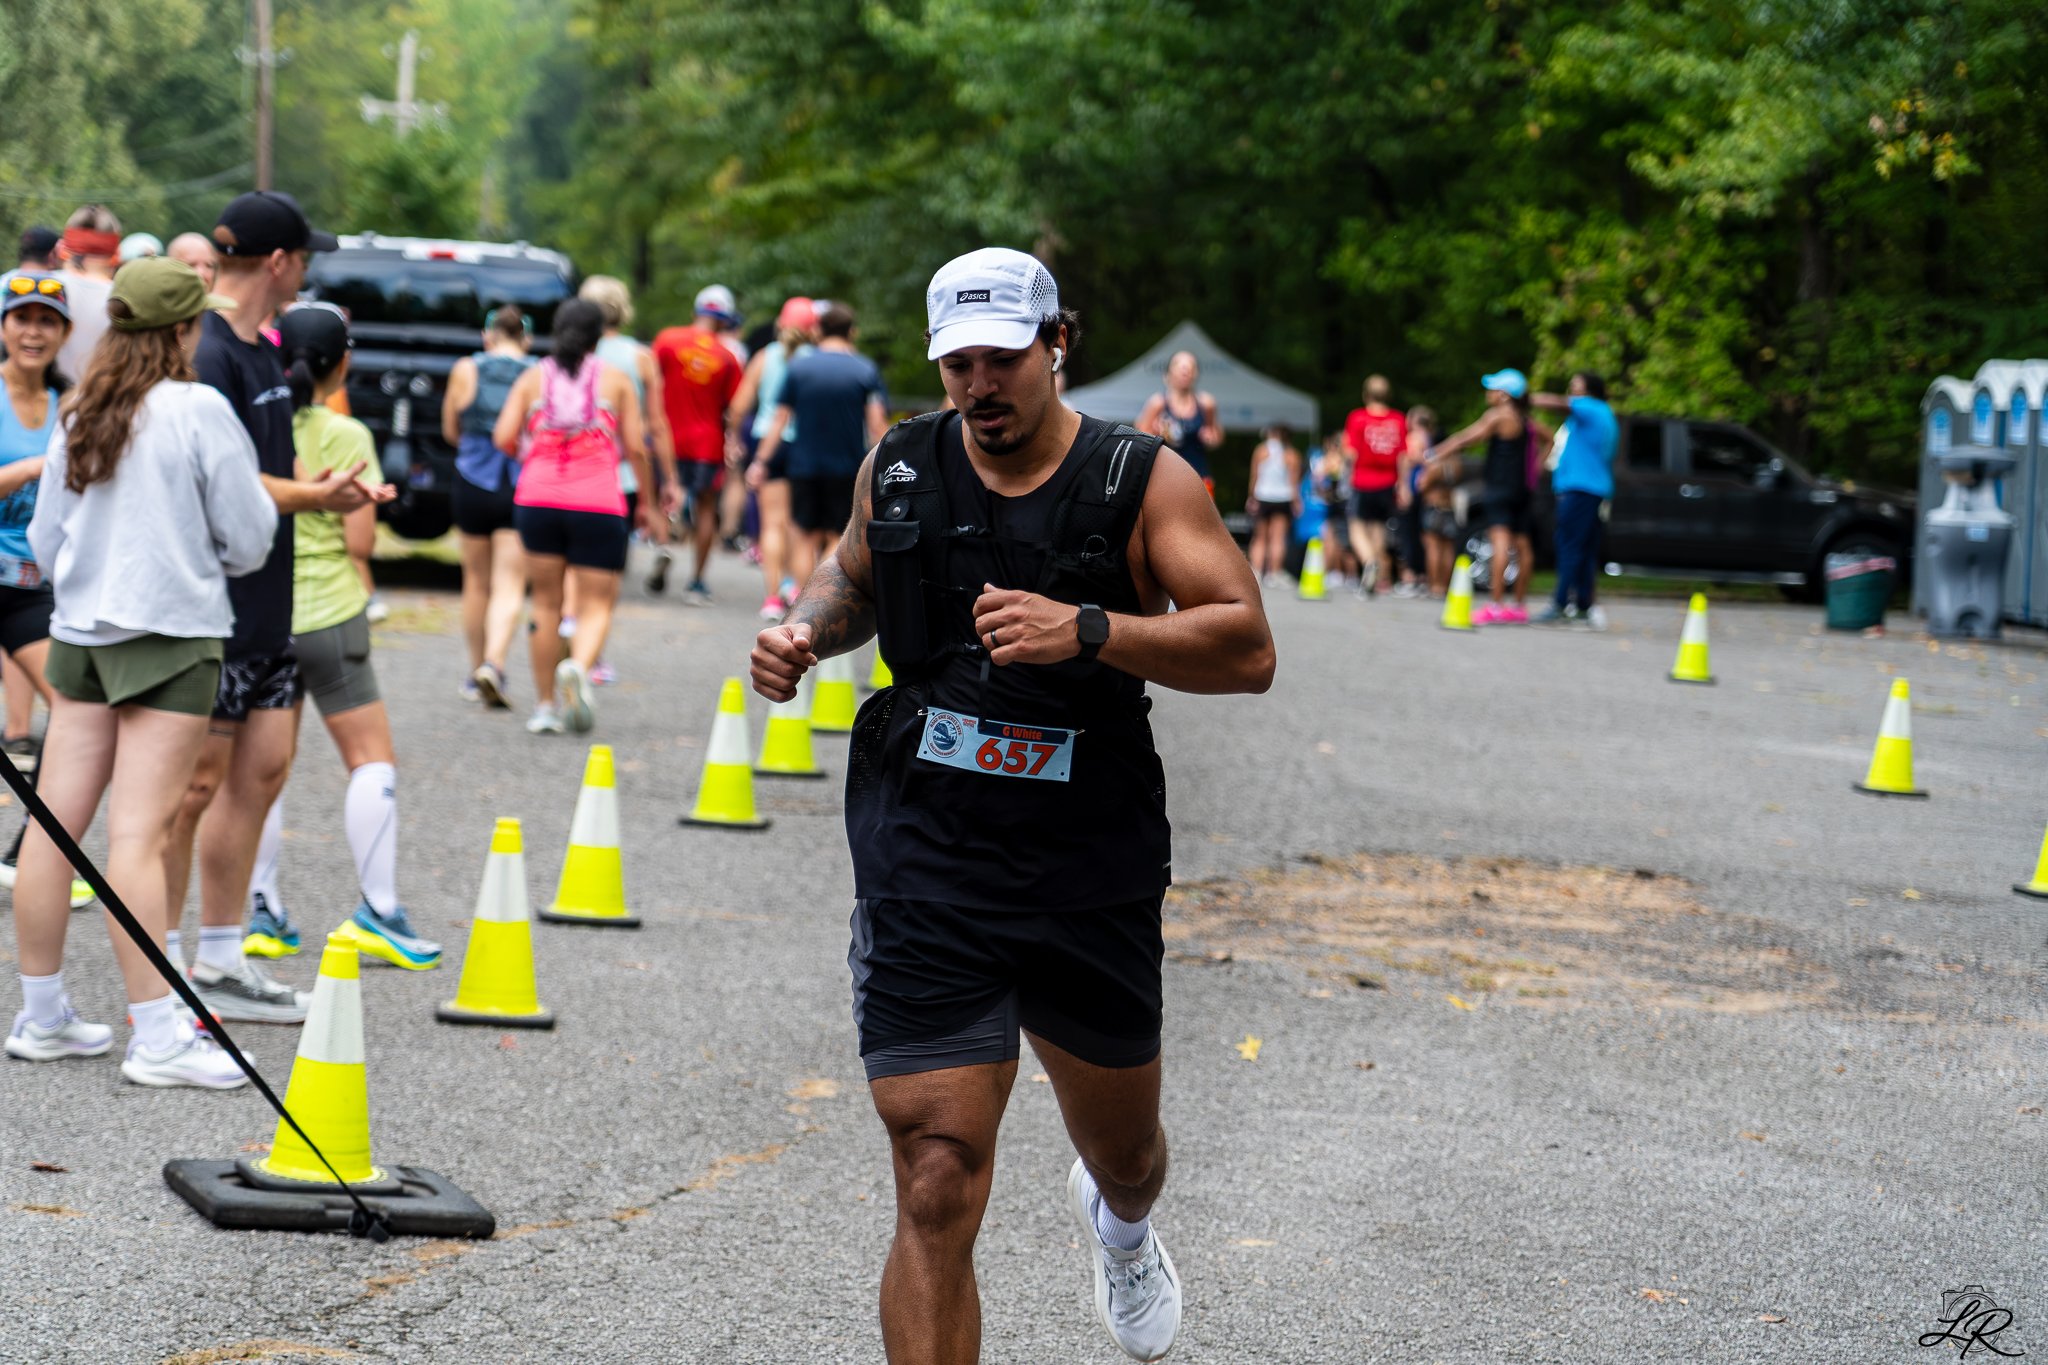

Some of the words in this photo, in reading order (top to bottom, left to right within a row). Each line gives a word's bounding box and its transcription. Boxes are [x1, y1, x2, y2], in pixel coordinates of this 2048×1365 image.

[1002, 725, 1010, 737] G
[1012, 727, 1042, 740] White
[975, 738, 1059, 775] 657
